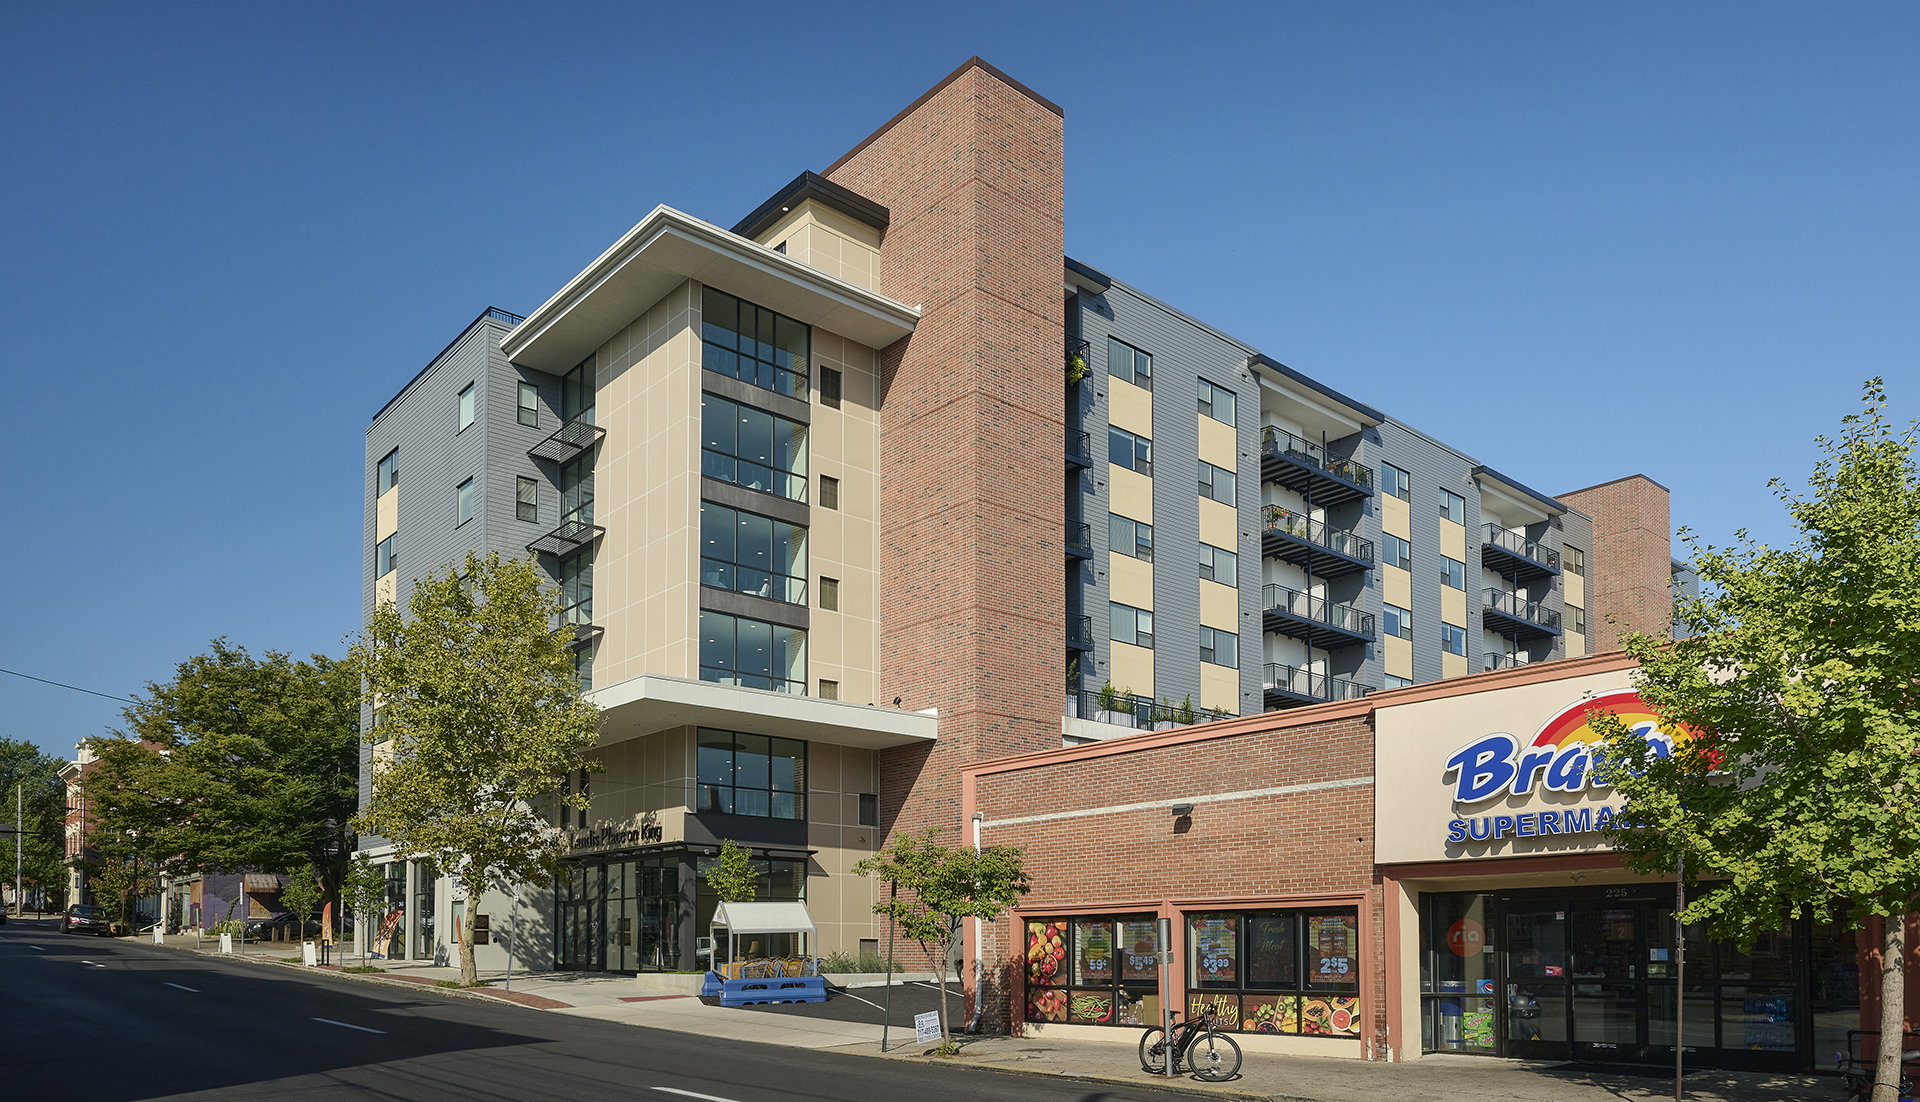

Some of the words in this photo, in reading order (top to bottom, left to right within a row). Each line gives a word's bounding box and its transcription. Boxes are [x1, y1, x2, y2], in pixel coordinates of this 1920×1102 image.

[601, 826, 626, 846] Place
[627, 829, 639, 842] on
[641, 823, 662, 843] King
[1606, 888, 1628, 898] 225
[1259, 921, 1285, 936] Fresh
[1453, 924, 1480, 942] ria
[1618, 928, 1625, 939] 2
[1256, 938, 1288, 953] Meat
[1089, 959, 1107, 971] 59¢
